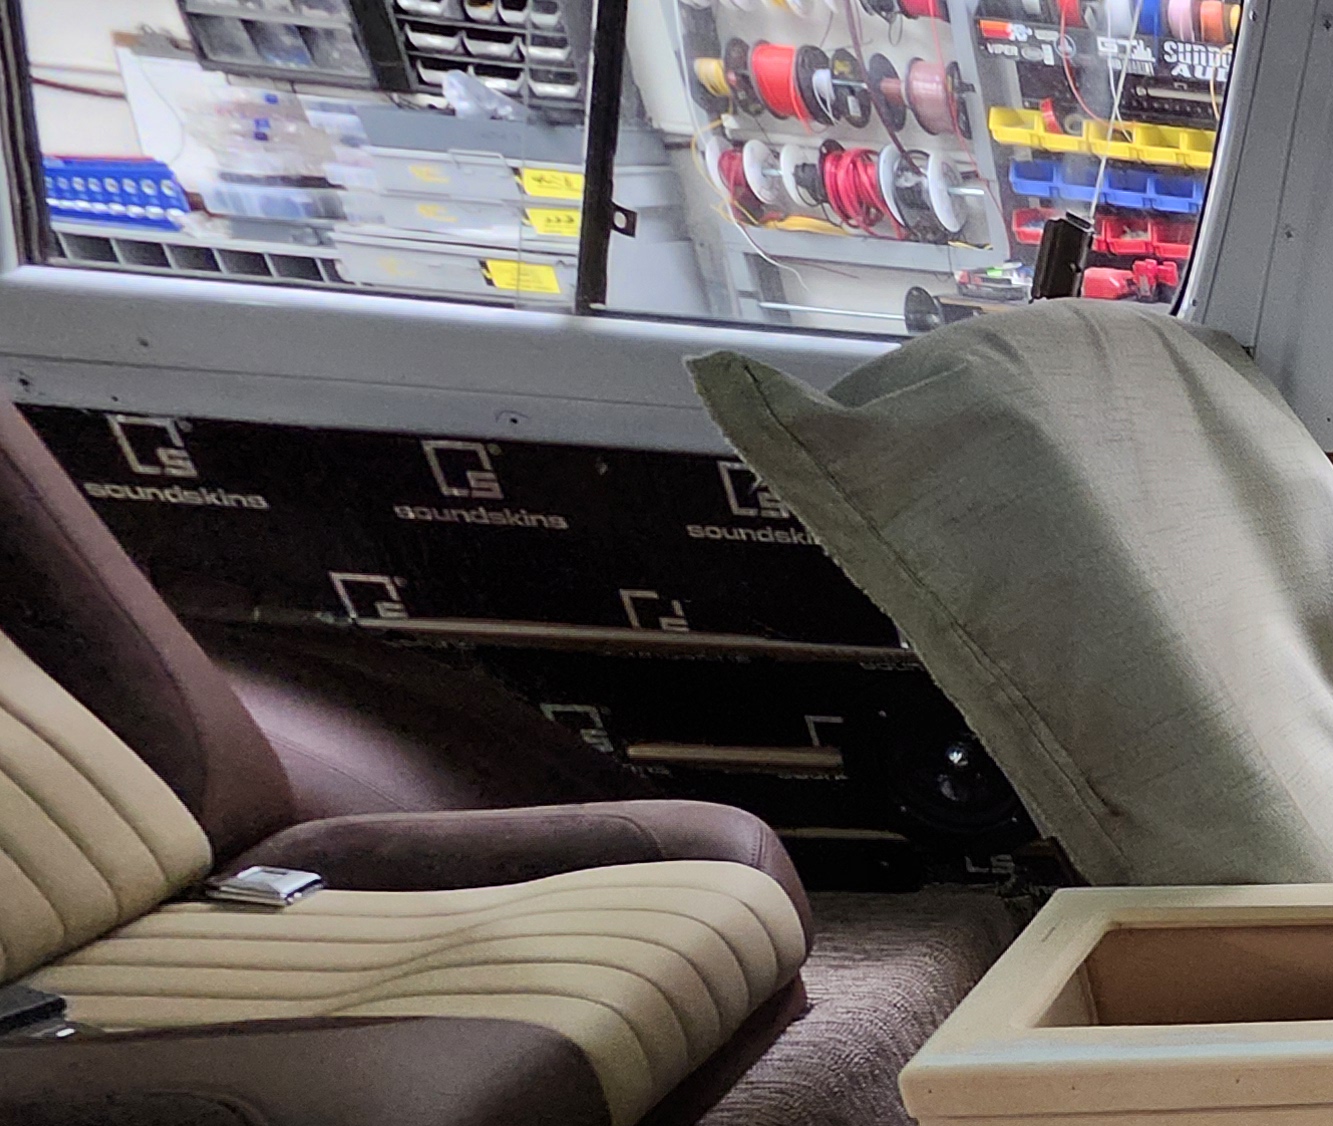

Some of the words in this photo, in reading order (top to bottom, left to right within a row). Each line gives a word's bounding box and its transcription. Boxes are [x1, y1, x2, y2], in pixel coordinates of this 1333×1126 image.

[83, 481, 269, 509] soundskins
[393, 504, 569, 530] soundskins
[687, 524, 815, 545] soundski
